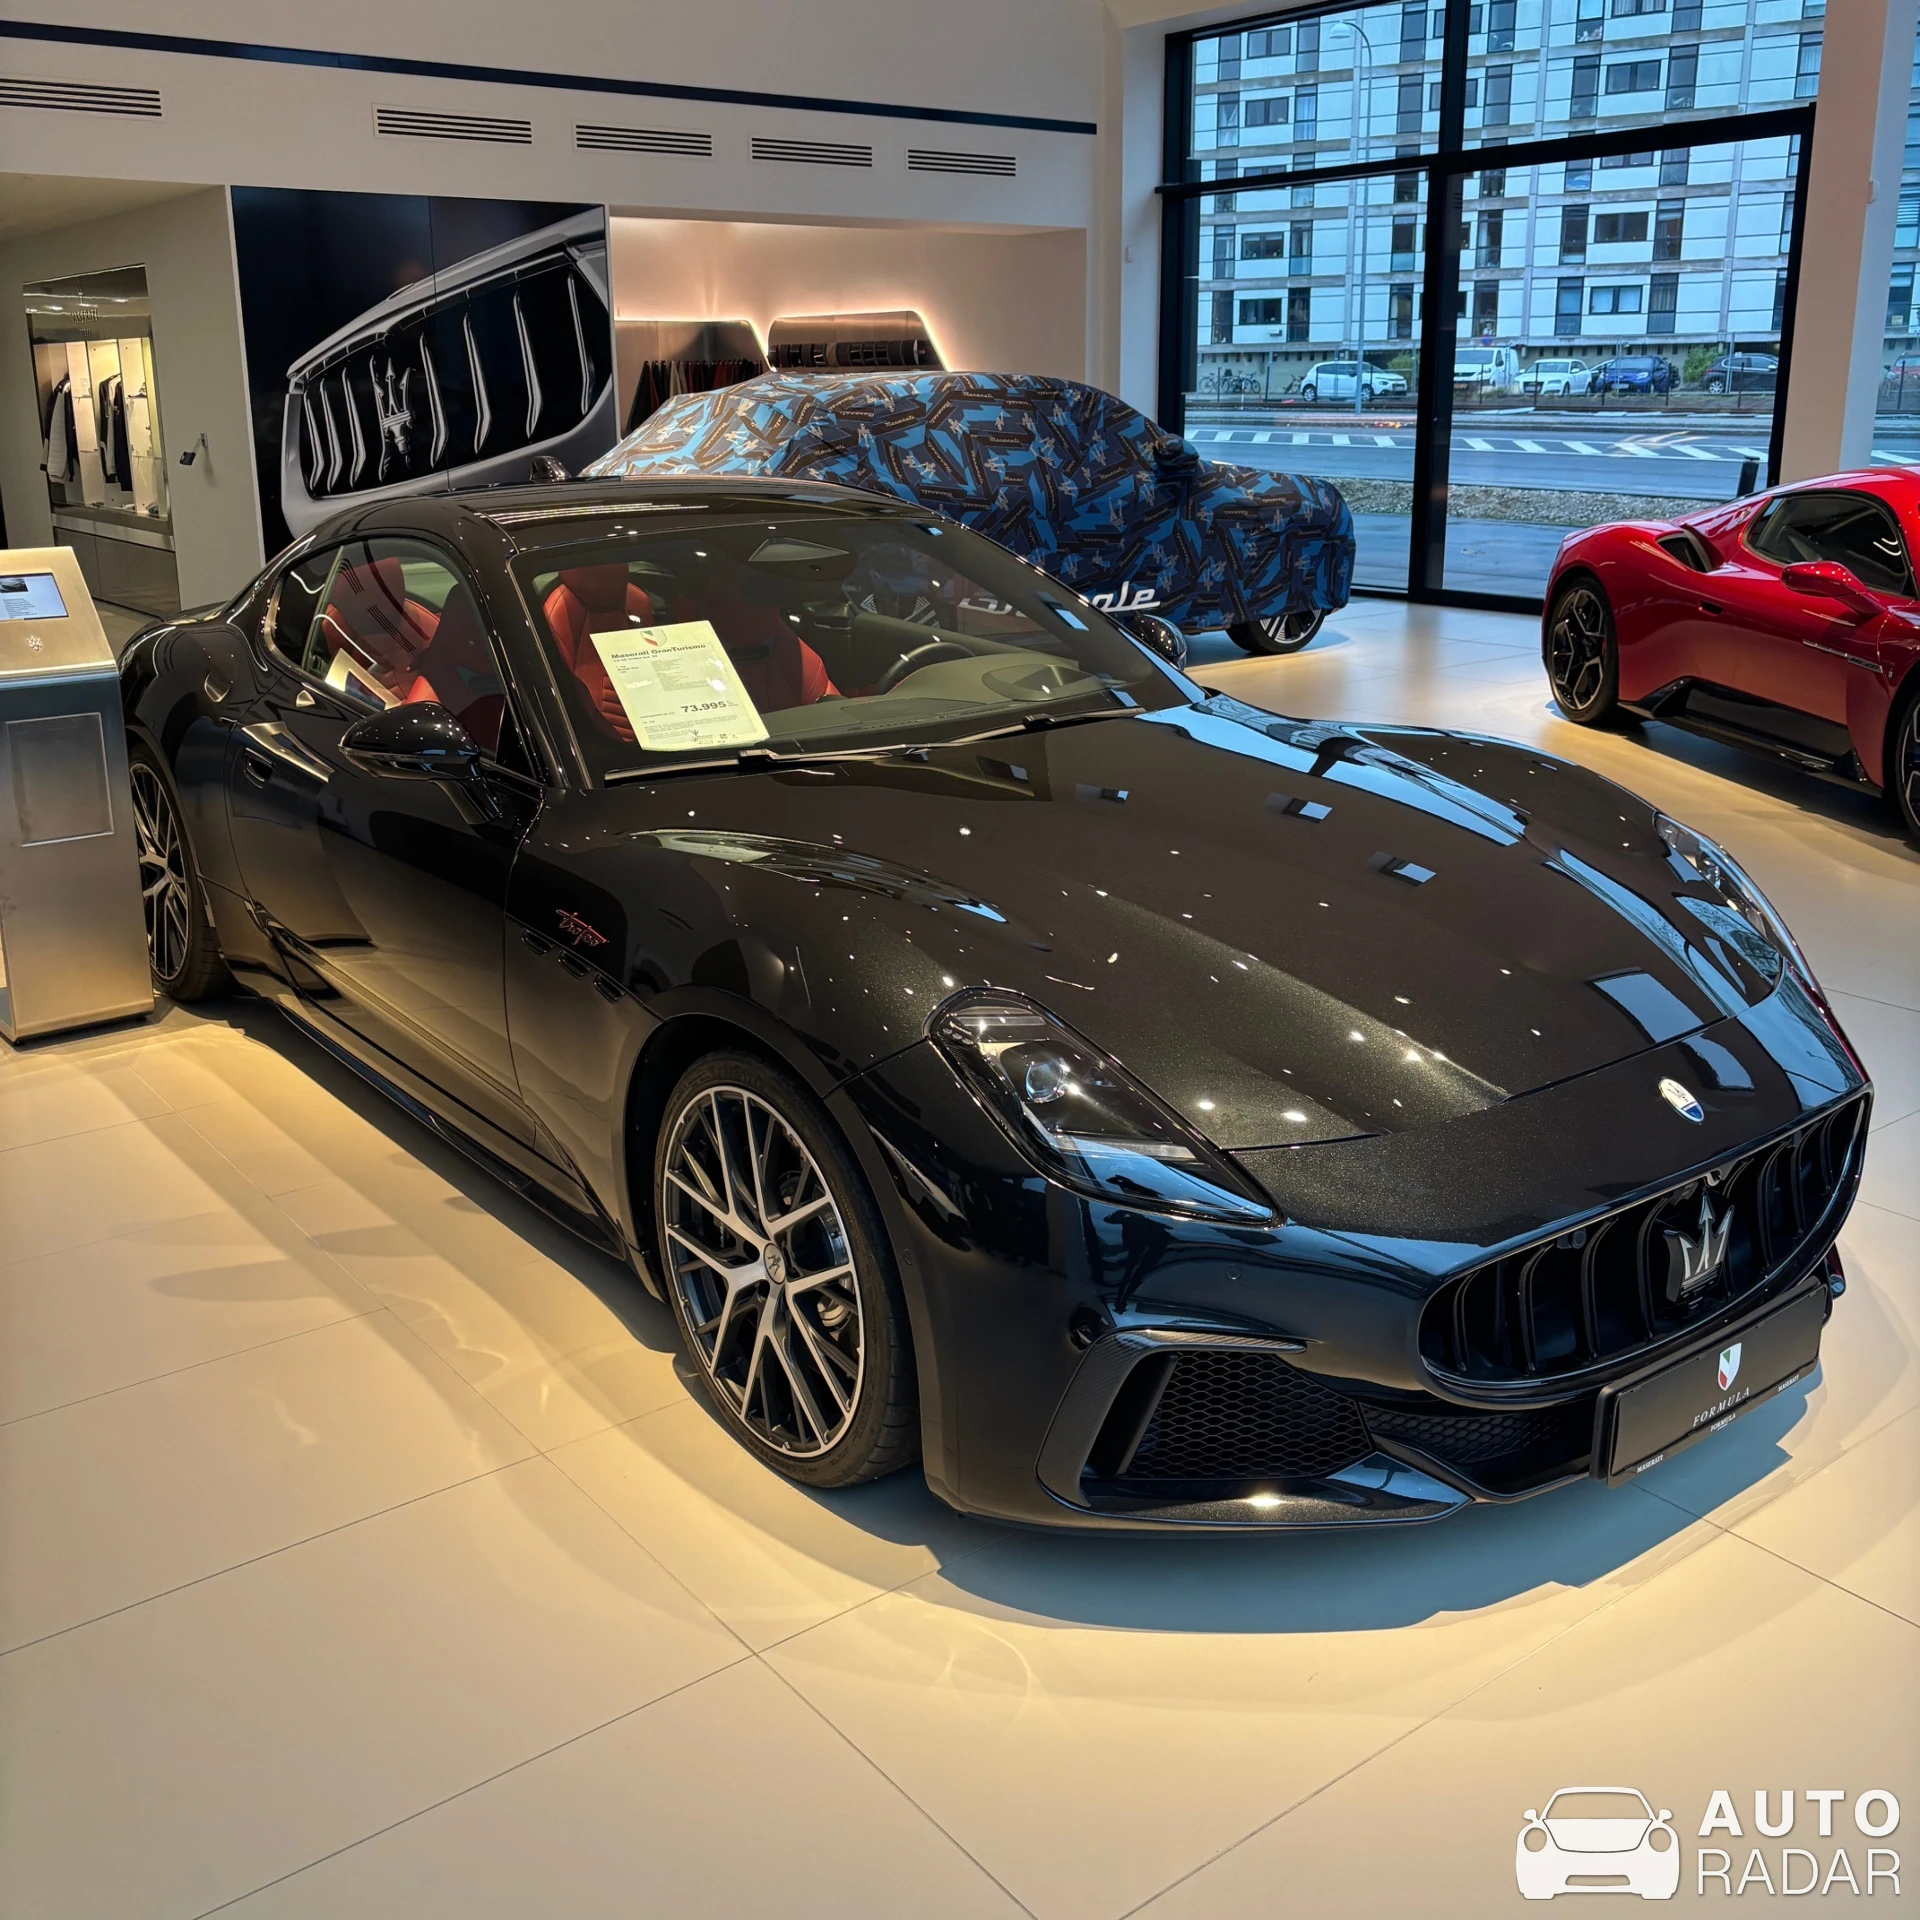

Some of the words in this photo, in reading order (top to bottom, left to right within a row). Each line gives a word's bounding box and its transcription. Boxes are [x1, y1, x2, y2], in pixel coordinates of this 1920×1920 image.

[611, 650, 650, 659] Maserati
[651, 644, 706, 655] GranTurismo
[680, 701, 727, 713] 73.995
[1692, 1386, 1750, 1427] FORMULA
[1710, 1413, 1737, 1432] FORMULA
